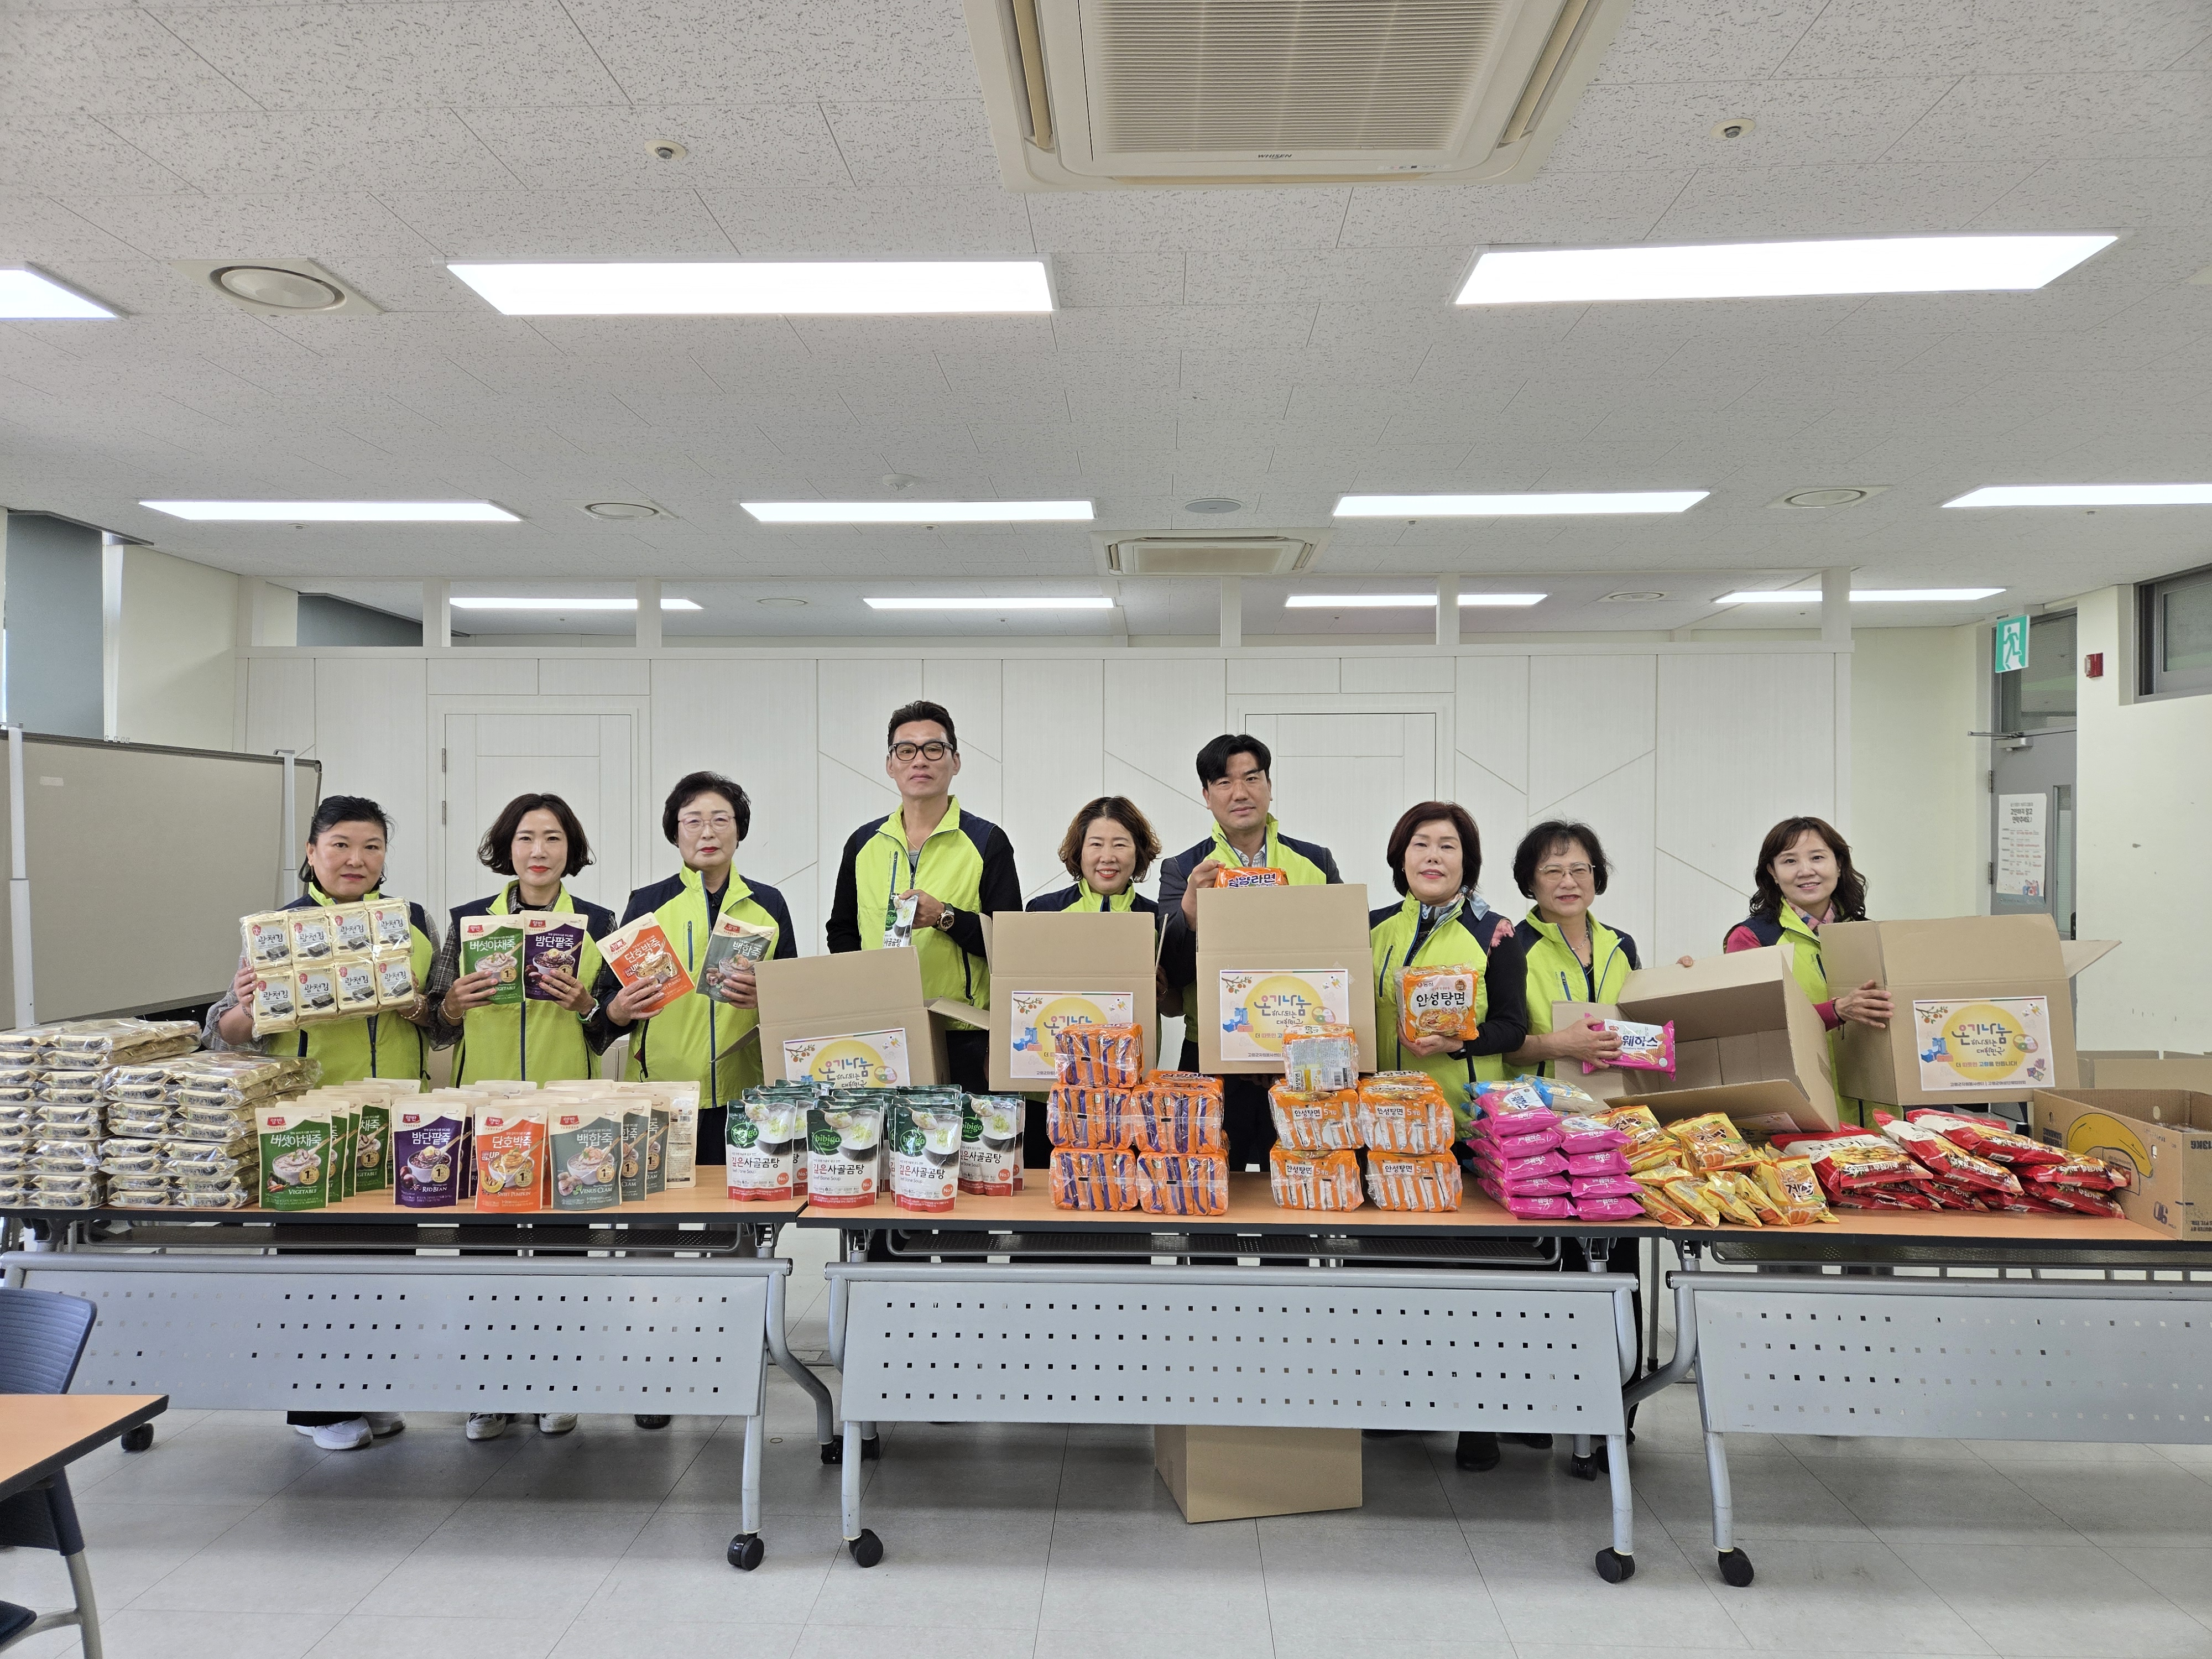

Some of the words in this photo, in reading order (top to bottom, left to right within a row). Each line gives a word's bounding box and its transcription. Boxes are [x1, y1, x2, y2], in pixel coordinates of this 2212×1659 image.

[1229, 873, 1276, 888] 삼양라면
[340, 925, 364, 934] 광천김
[380, 919, 404, 929] 광천김
[258, 933, 283, 944] 광천김
[299, 931, 324, 940] 광천김
[470, 939, 516, 952] 버섯야채죽
[535, 936, 574, 948] 밤단팥죽
[624, 938, 662, 963] 단호박죽
[733, 941, 761, 958] 백합죽
[345, 975, 369, 985] 광천김
[384, 971, 406, 982] 광천김
[304, 982, 329, 992] 광천김
[263, 990, 289, 1000] 광천김
[1416, 992, 1465, 1007] 안성탕면
[1254, 995, 1312, 1016] 온기나눔
[1272, 1010, 1297, 1019] 하나되는
[1952, 1023, 2012, 1045] 온기나눔
[1623, 1036, 1658, 1047] 웨하스
[1970, 1039, 1997, 1047] 하나되는
[1976, 1047, 2005, 1056] 대한민국
[818, 1057, 874, 1081] 온기나눔
[836, 1073, 860, 1081] 하나되는
[412, 1131, 451, 1145] 밤단팥죽
[577, 1133, 613, 1147] 백합죽
[623, 1128, 638, 1141] 합죽
[815, 1134, 842, 1145] bibigo
[270, 1134, 322, 1147] 버섯야채죽
[492, 1135, 532, 1149] 단호박죽
[813, 1164, 864, 1175] 깊은사골곰탕
[1287, 1165, 1312, 1175] 안성탕면
[1385, 1165, 1412, 1173] 안성탕면
